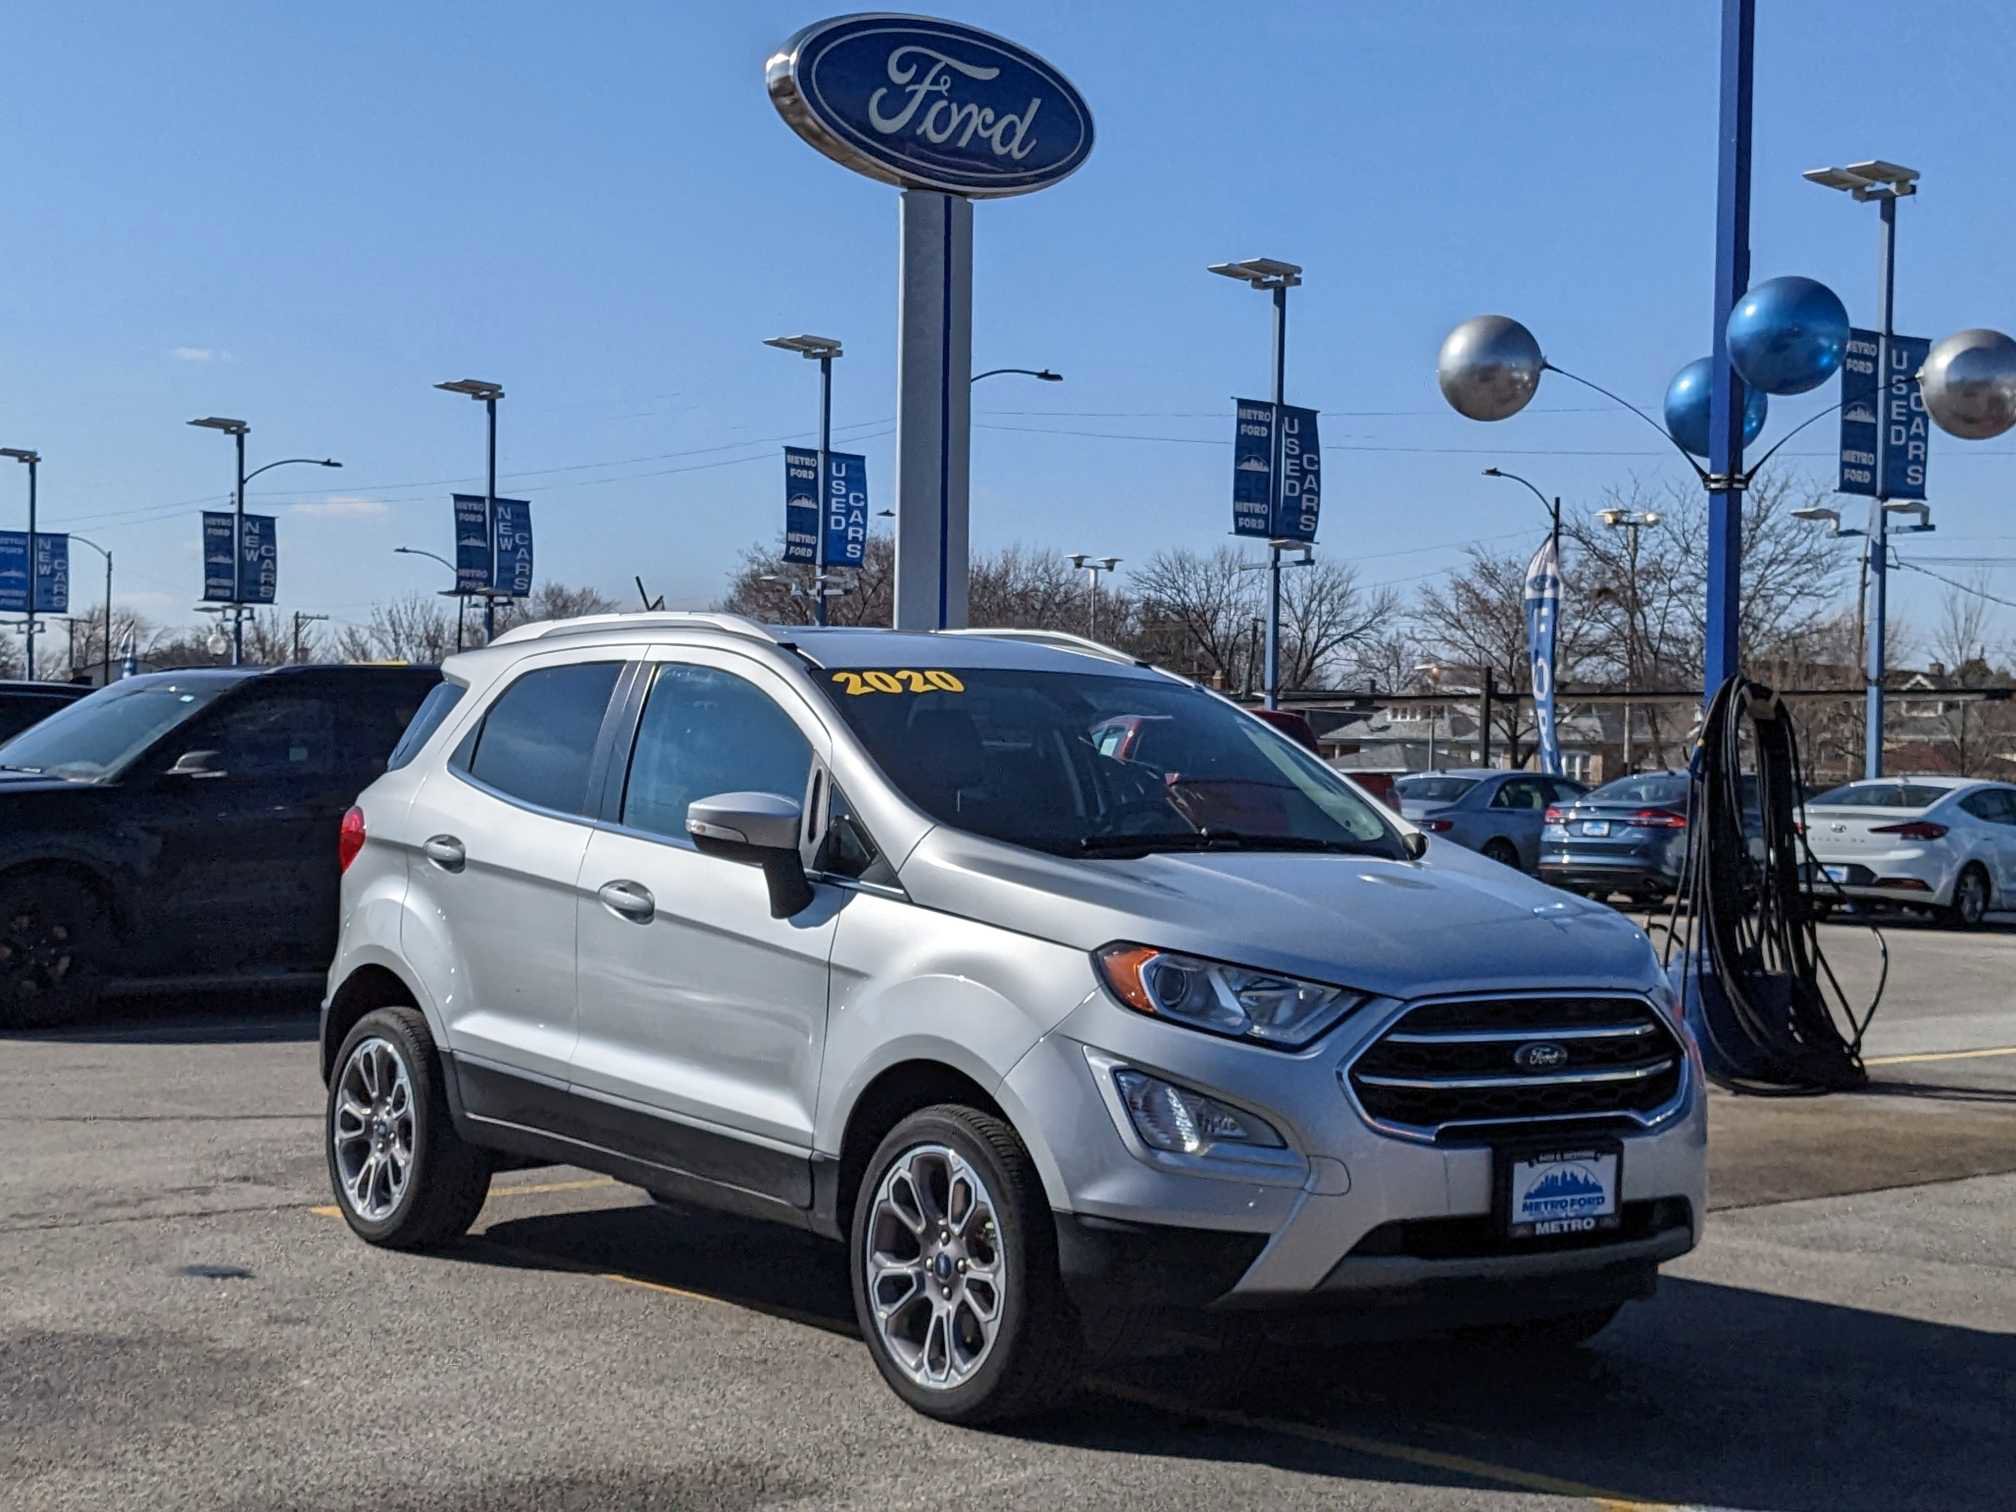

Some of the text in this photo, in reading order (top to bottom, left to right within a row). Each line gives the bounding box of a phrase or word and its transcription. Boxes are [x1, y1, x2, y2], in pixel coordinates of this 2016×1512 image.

[868, 46, 1042, 160] Ford
[1846, 358, 1874, 374] FORD
[1890, 349, 1908, 446] USED
[1239, 408, 1271, 422] METRO
[1240, 424, 1268, 438] FORD
[1905, 391, 1927, 486] CARS
[787, 454, 817, 467] METRO
[1284, 416, 1301, 497] USED
[1842, 449, 1876, 466] METRO
[789, 468, 815, 480] FORD
[1843, 468, 1871, 484] FORD
[830, 462, 847, 531] USED
[1299, 454, 1319, 532] CARS
[1235, 501, 1268, 514] METRO
[498, 506, 513, 551] NEW
[845, 492, 865, 559] CARS
[1238, 517, 1265, 530] FORD
[244, 521, 259, 561] NEW
[788, 532, 817, 545] METRO
[38, 538, 51, 575] NEW
[513, 532, 530, 591] CARS
[789, 547, 813, 558] FORD
[259, 544, 275, 598] CARS
[831, 670, 965, 696] 2020
[1529, 1047, 1559, 1065] Ford
[1521, 1199, 1569, 1213] METRO
[1570, 1196, 1606, 1207] FORD
[1535, 1217, 1596, 1236] METRO
